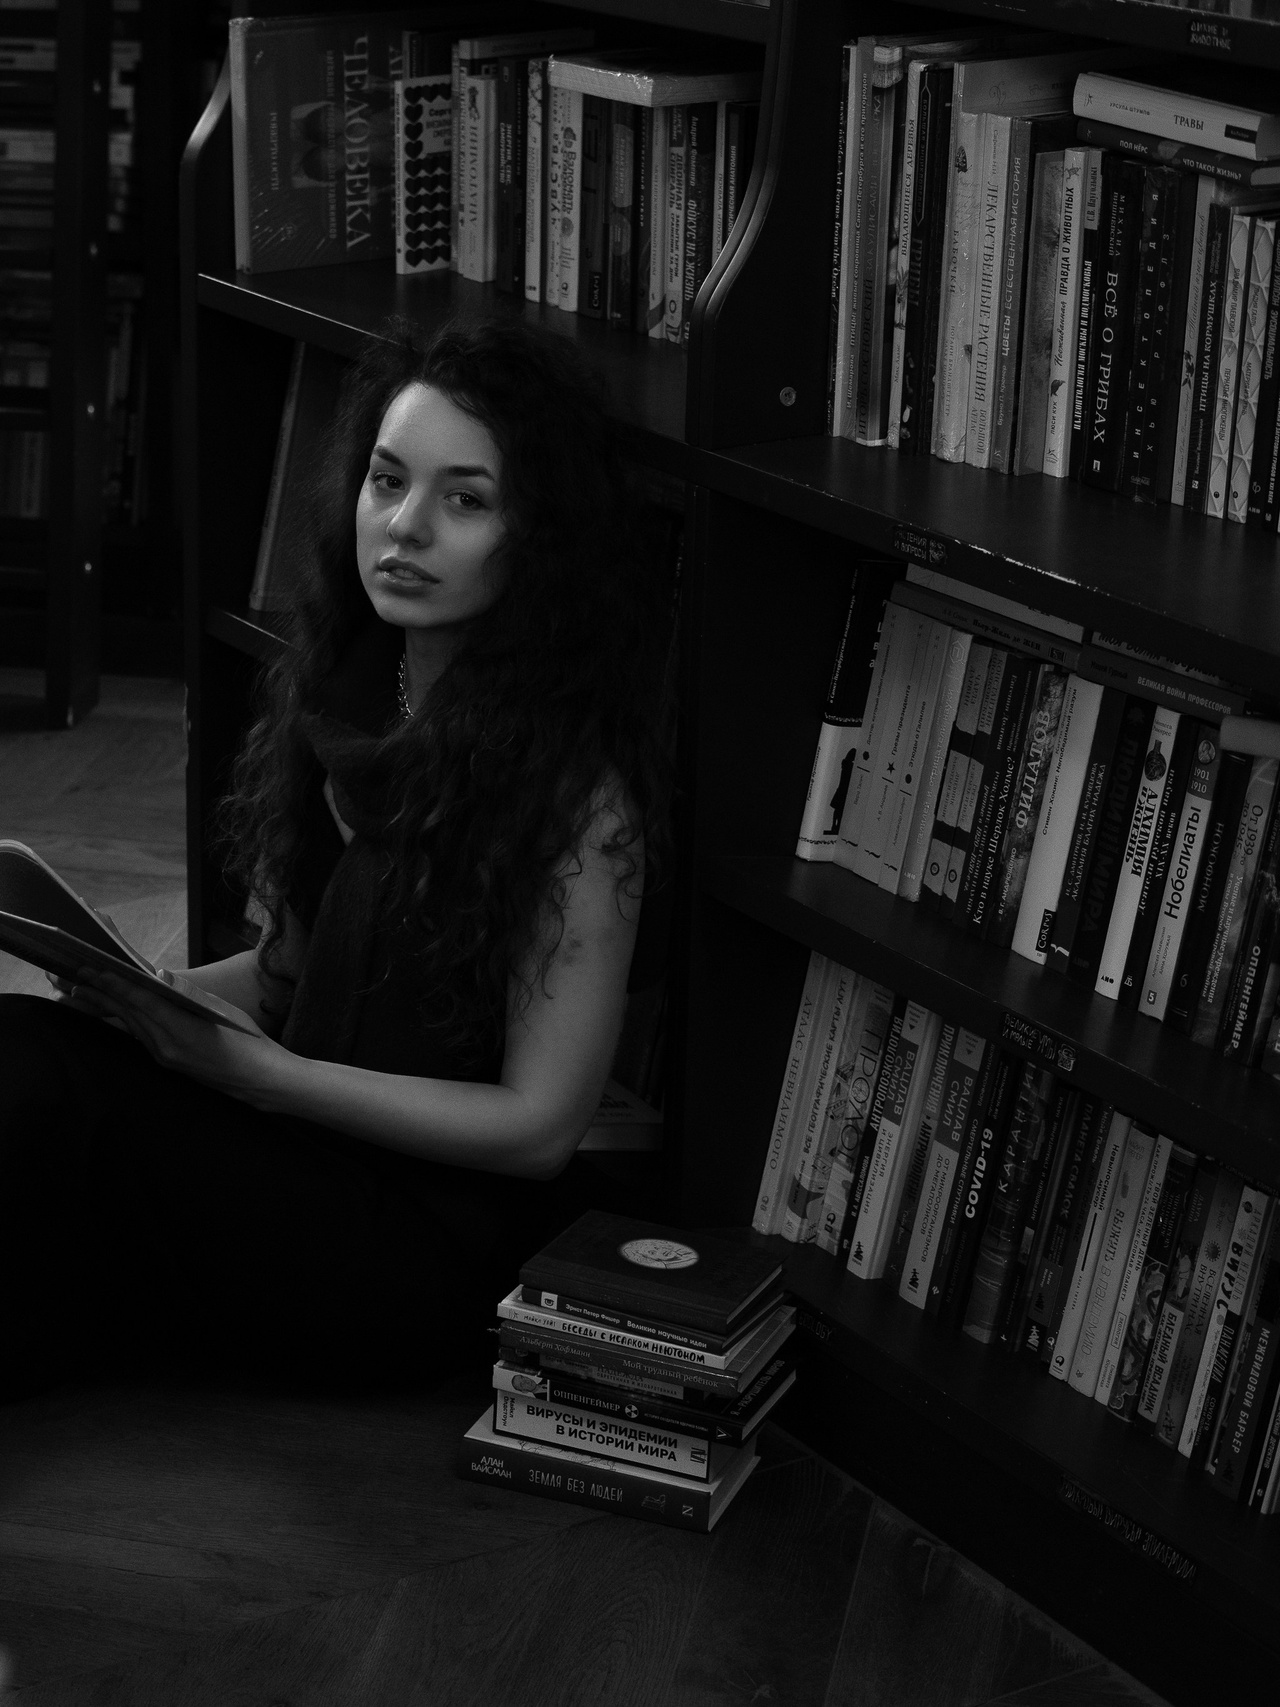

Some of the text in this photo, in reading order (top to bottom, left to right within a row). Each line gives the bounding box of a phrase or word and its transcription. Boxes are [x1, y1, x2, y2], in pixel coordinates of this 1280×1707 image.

[342, 36, 371, 247] ЧЕЛОВЕКА
[497, 122, 506, 182] САМОУБИЙСТВО
[1173, 114, 1204, 131] ТРАВЫ
[564, 151, 576, 214] Взломать
[667, 151, 677, 207] СПИРАЛЬ
[674, 154, 683, 210] ДВОЙНАЯ
[899, 117, 916, 256] ВЫДАЮЩИЕСЯ ДЕРЕВЬЯ
[1120, 140, 1242, 181] ПОЛ НЁРС ЧТО ТАКОЕ ЖИЗНЬ?
[683, 116, 698, 301] Андрей Фоменко ФОКУС НА ЖИЗНЬ
[1061, 186, 1074, 245] ЖИВОТНЫХ
[1107, 191, 1119, 256] ВИШНЕВСКИЙ
[949, 228, 960, 294] БАБОЧКИ
[1000, 156, 1021, 357] ЦВЕТЫ ЕСТЕСТВЕННАЯ ИСТОРИЯ
[1059, 256, 1070, 296] ПРАВДА
[1061, 246, 1071, 254] О
[974, 180, 999, 402] ЛЕКАРСТВЕННЫЕ РАСТЕНИЯ
[858, 279, 874, 435] ИГОРЬ СОСНОВСКИЙ
[1072, 259, 1093, 431] ПАЛЕОНТОЛОГИЯ МОСКВЫ И ПОДМОСКОВЬЯ
[1092, 270, 1121, 443] ВСЁ О ГРИБАХ
[1198, 279, 1218, 412] ПТИЦЫ НА КОРМУШКАХ
[1263, 273, 1280, 380] УИЛСОН ЭУСОЦИАЛЬНОСТЬ
[969, 405, 978, 436] АТЛАС
[976, 407, 987, 454] БОЛЬШОЙ
[1136, 675, 1232, 716] ВЕЛИКАЯ ВОЙНА ПРОФЕССОРОВ
[1042, 808, 1053, 836] Стивен
[1055, 716, 1072, 773] Непобедимый
[1067, 686, 1078, 717] разум
[1104, 738, 1138, 822] ЛЮДИ
[1190, 780, 1208, 796] 1910
[1193, 765, 1210, 782] 1901
[999, 846, 1017, 900] АНДРЮЩЕНКО
[1012, 708, 1052, 831] ФИЛАТОВ
[1069, 763, 1107, 901] АКАДЕМИЯ БЛАГИХ НАДЕЖД
[1130, 787, 1159, 877] АЛХИМИЯ
[972, 755, 1016, 925] Кто в науке Шерлок Холмс?
[1134, 768, 1176, 916] Деятели русской науки
[1162, 806, 1205, 920] Нобелиаты
[1192, 822, 1228, 912] МОНФОКОН
[1080, 852, 1113, 935] МИРА
[1204, 873, 1243, 1004] Ученые и научные учреждения
[1229, 944, 1263, 1049] ОППЕНГЕЙМЕР
[768, 993, 813, 1171] АТЛАС НЕВИДИМОГО
[801, 978, 847, 1155] ВСЕ ГЕОГРАФИЧЕСКИЕ КАРТЫ ЛГУТ
[832, 1028, 883, 1173] ПРОЛОГ
[866, 1014, 906, 1132] АНТРОПОЭКОЛОГИЯ
[886, 1053, 903, 1100] СМИЛ
[893, 1049, 914, 1115] ВАЦЛАВ
[924, 1023, 956, 1114] ПРИКЛЮЧЕНИЯ
[941, 1078, 960, 1127] СМИЛ
[949, 1075, 974, 1143] ВАЦЛАВ
[1072, 1102, 1094, 1164] ПЛАНЕТА
[862, 1136, 884, 1215] ЦИВИЛИЗАЦИЯ
[878, 1129, 894, 1177] ЭНЕРГИЯ
[948, 1117, 979, 1224] СМЕРТЕЛЬНЫЕ СПУТНИКИ
[963, 1125, 994, 1220] COVID-19
[1097, 1143, 1119, 1211] Невыносимый
[919, 1152, 944, 1236] ДО МЕГАПОЛИСОВ
[919, 1156, 950, 1263] ОТ МИКРООРГАНИЗМОВ
[1058, 1162, 1079, 1219] СВАЛОК
[1091, 1177, 1103, 1208] мусор
[1150, 1180, 1161, 1204] ТВОЙ
[1133, 1247, 1144, 1272] ДЕНЬ
[1215, 1239, 1243, 1311] ВИРУС
[1231, 1207, 1263, 1301] АРКАДИЙ НЕДЕЛЬ
[565, 1303, 706, 1349] Эрнст Петер Фишер Великие научные идеи
[1183, 1262, 1208, 1335] ВНУТРИ НАС
[1193, 1266, 1216, 1336] ВСЕЛЕННАЯ
[521, 1334, 718, 1389] Альберт Хофманн Мой трудный ребёнок
[562, 1321, 595, 1339] БЕСЕДЫ
[609, 1332, 648, 1351] ИСААКОМ
[651, 1341, 704, 1365] НЬЮТОНОМ
[1143, 1310, 1180, 1414] БЛЕДНЫЙ ВСАДНИК
[1242, 1325, 1271, 1408] МЕЖВИДОВОЙ
[501, 1396, 509, 1427] Олдстоун
[508, 1397, 516, 1419] Майкл
[526, 1403, 677, 1449] ВИРУСЫ И ЭПИДЕМИИ
[553, 1386, 620, 1413] ОППЕНГЕЙМЕР
[1229, 1408, 1249, 1454] БАРЬЕР
[471, 1461, 511, 1479] ВАЙСМАН
[480, 1454, 503, 1468] АЛАН
[556, 1424, 676, 1461] В ИСТОРИИ МИРА
[528, 1467, 623, 1503] ЗЕМЛЯ БЕЗ ЛЮДЕЙ
